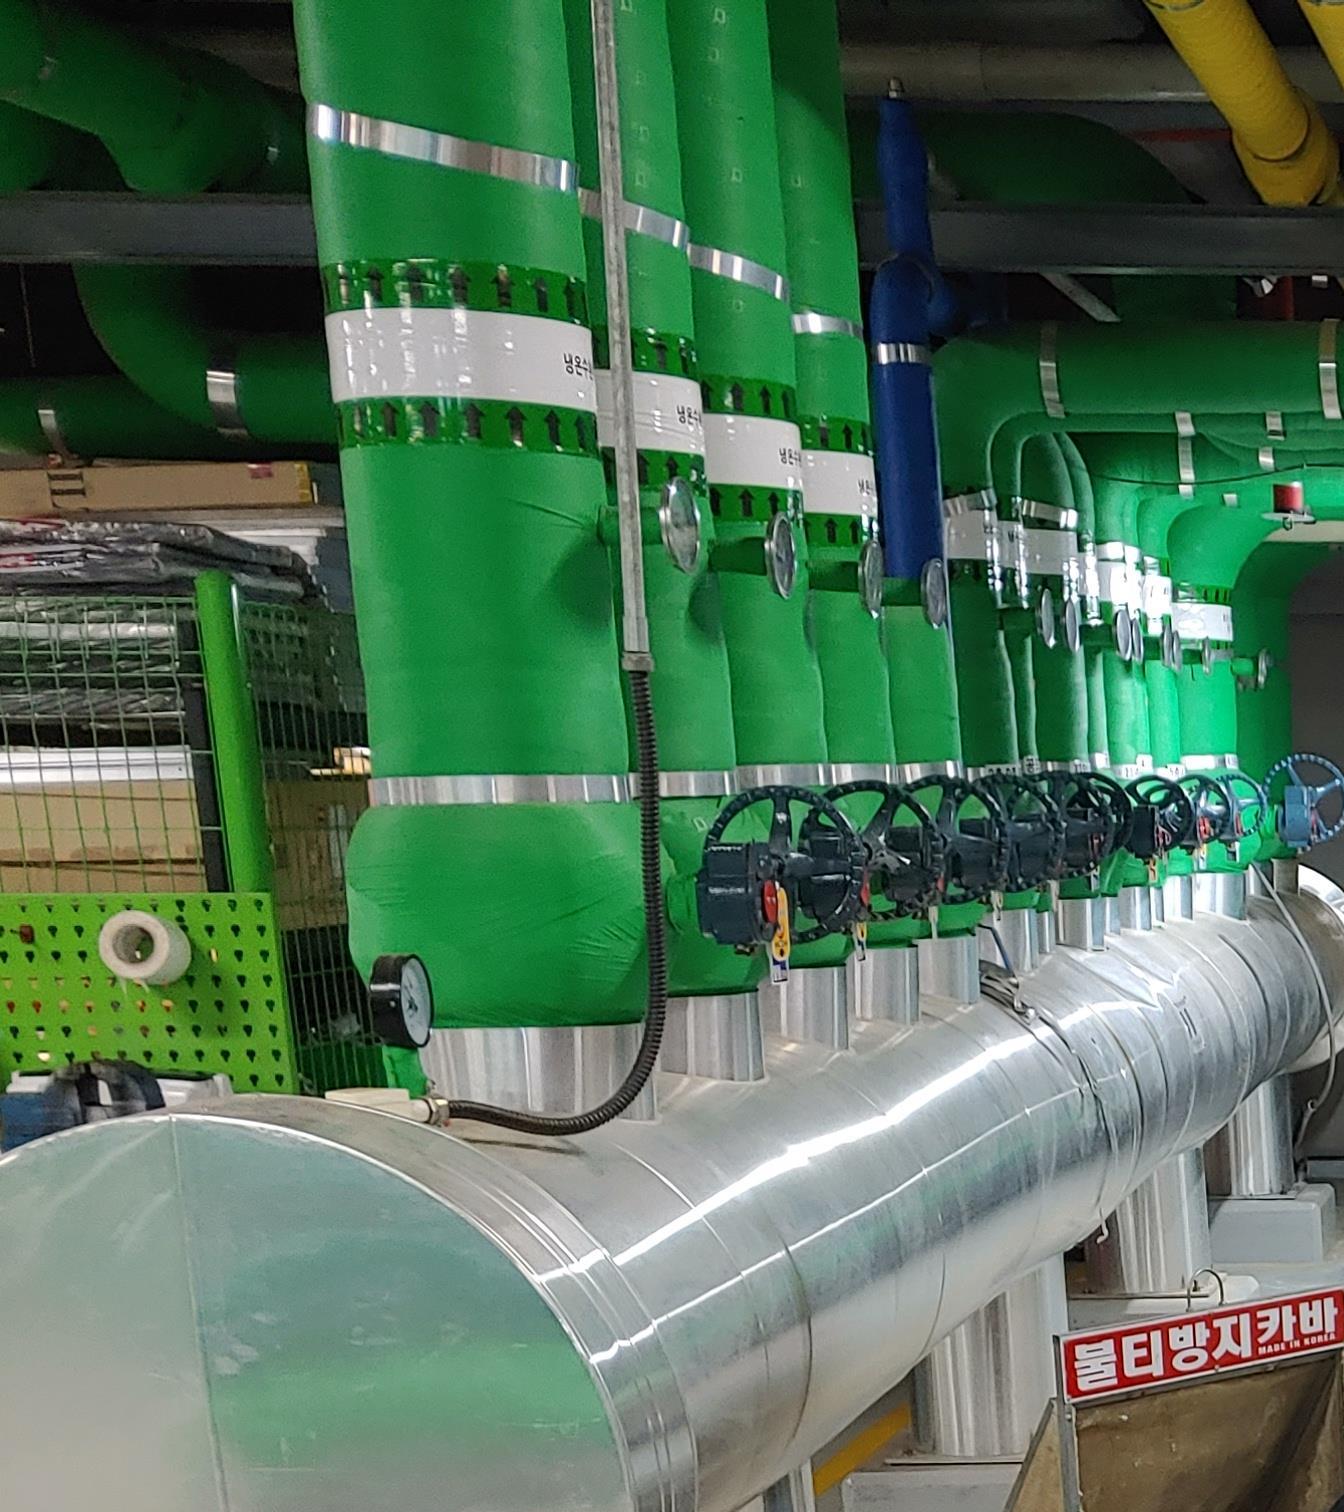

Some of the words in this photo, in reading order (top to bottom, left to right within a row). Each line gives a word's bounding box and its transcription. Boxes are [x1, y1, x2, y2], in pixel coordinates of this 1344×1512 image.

[1074, 1297, 1338, 1392] 불티방지카바
[1258, 1343, 1286, 1355] MADE
[1290, 1340, 1301, 1349] IN
[1304, 1332, 1337, 1347] KOREA
